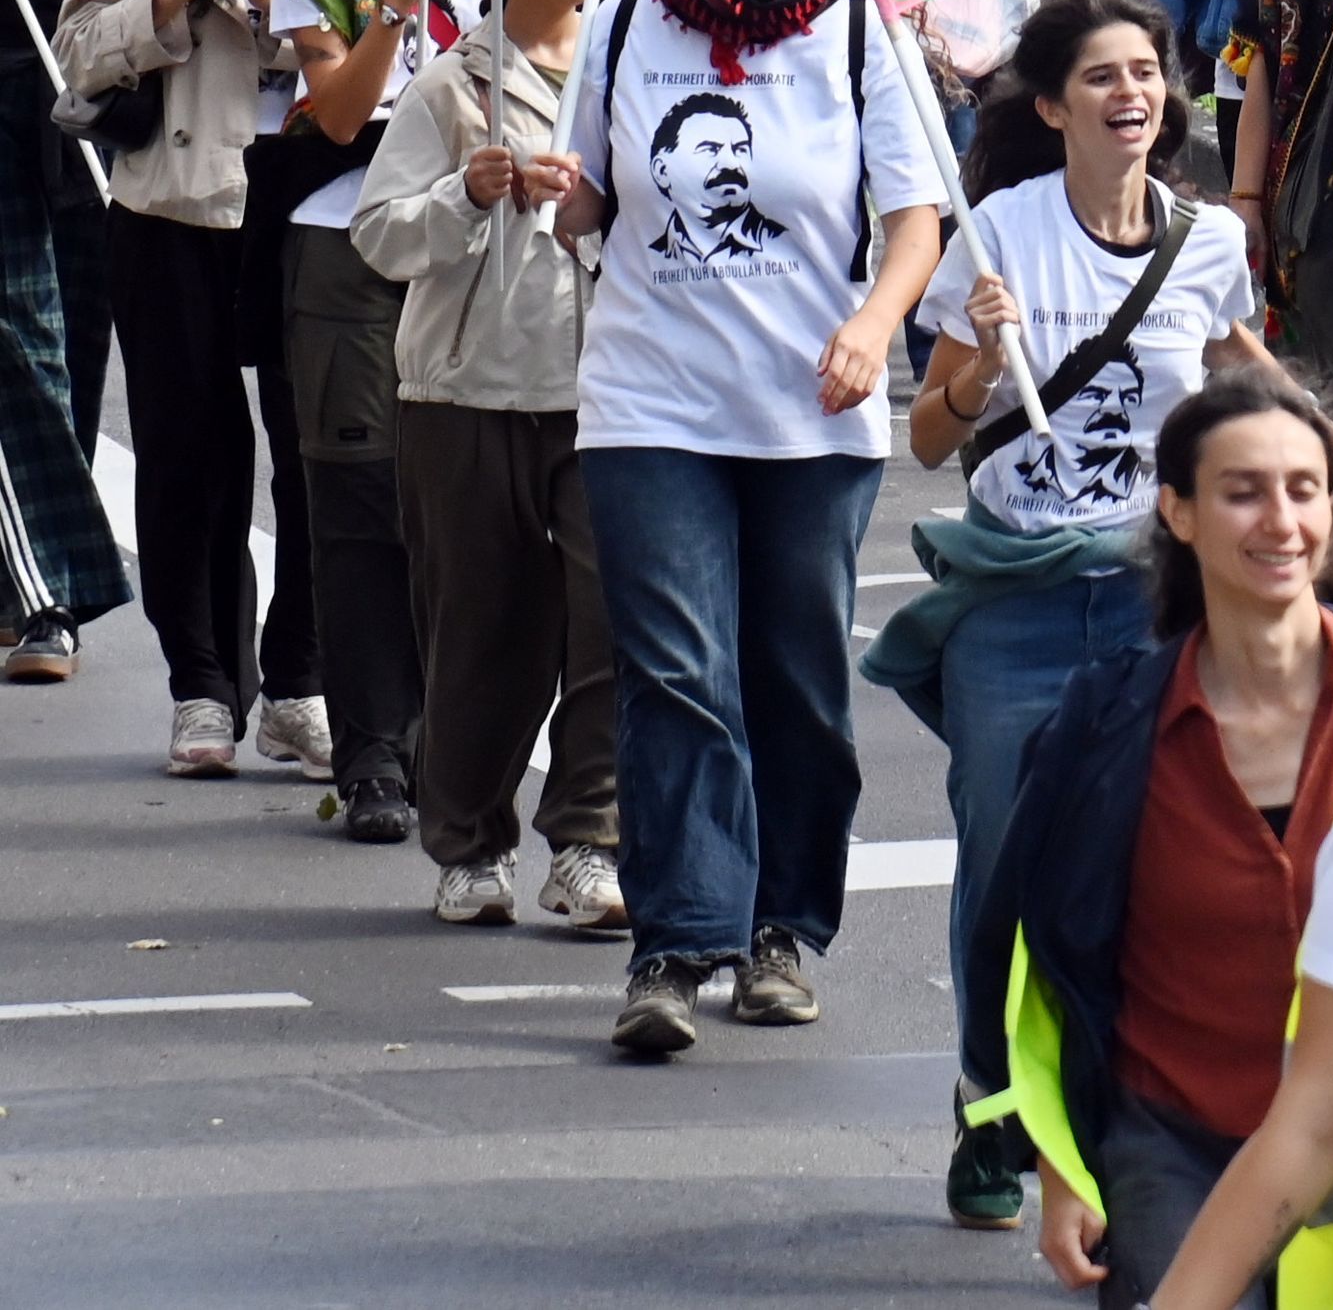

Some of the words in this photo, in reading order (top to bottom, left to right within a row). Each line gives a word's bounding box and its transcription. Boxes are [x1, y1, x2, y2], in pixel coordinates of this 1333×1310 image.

[643, 68, 660, 85] FÜR
[662, 72, 705, 86] FREIHEIT
[708, 73, 723, 86] UN
[653, 267, 690, 285] FREIHEIT
[691, 266, 710, 281] FÜR
[712, 261, 762, 279] ABDULLAH
[764, 258, 801, 277] ÖCALAN
[1032, 306, 1052, 325] FÜR
[1054, 311, 1098, 327] FREIHEIT
[1045, 498, 1066, 517] FÜR
